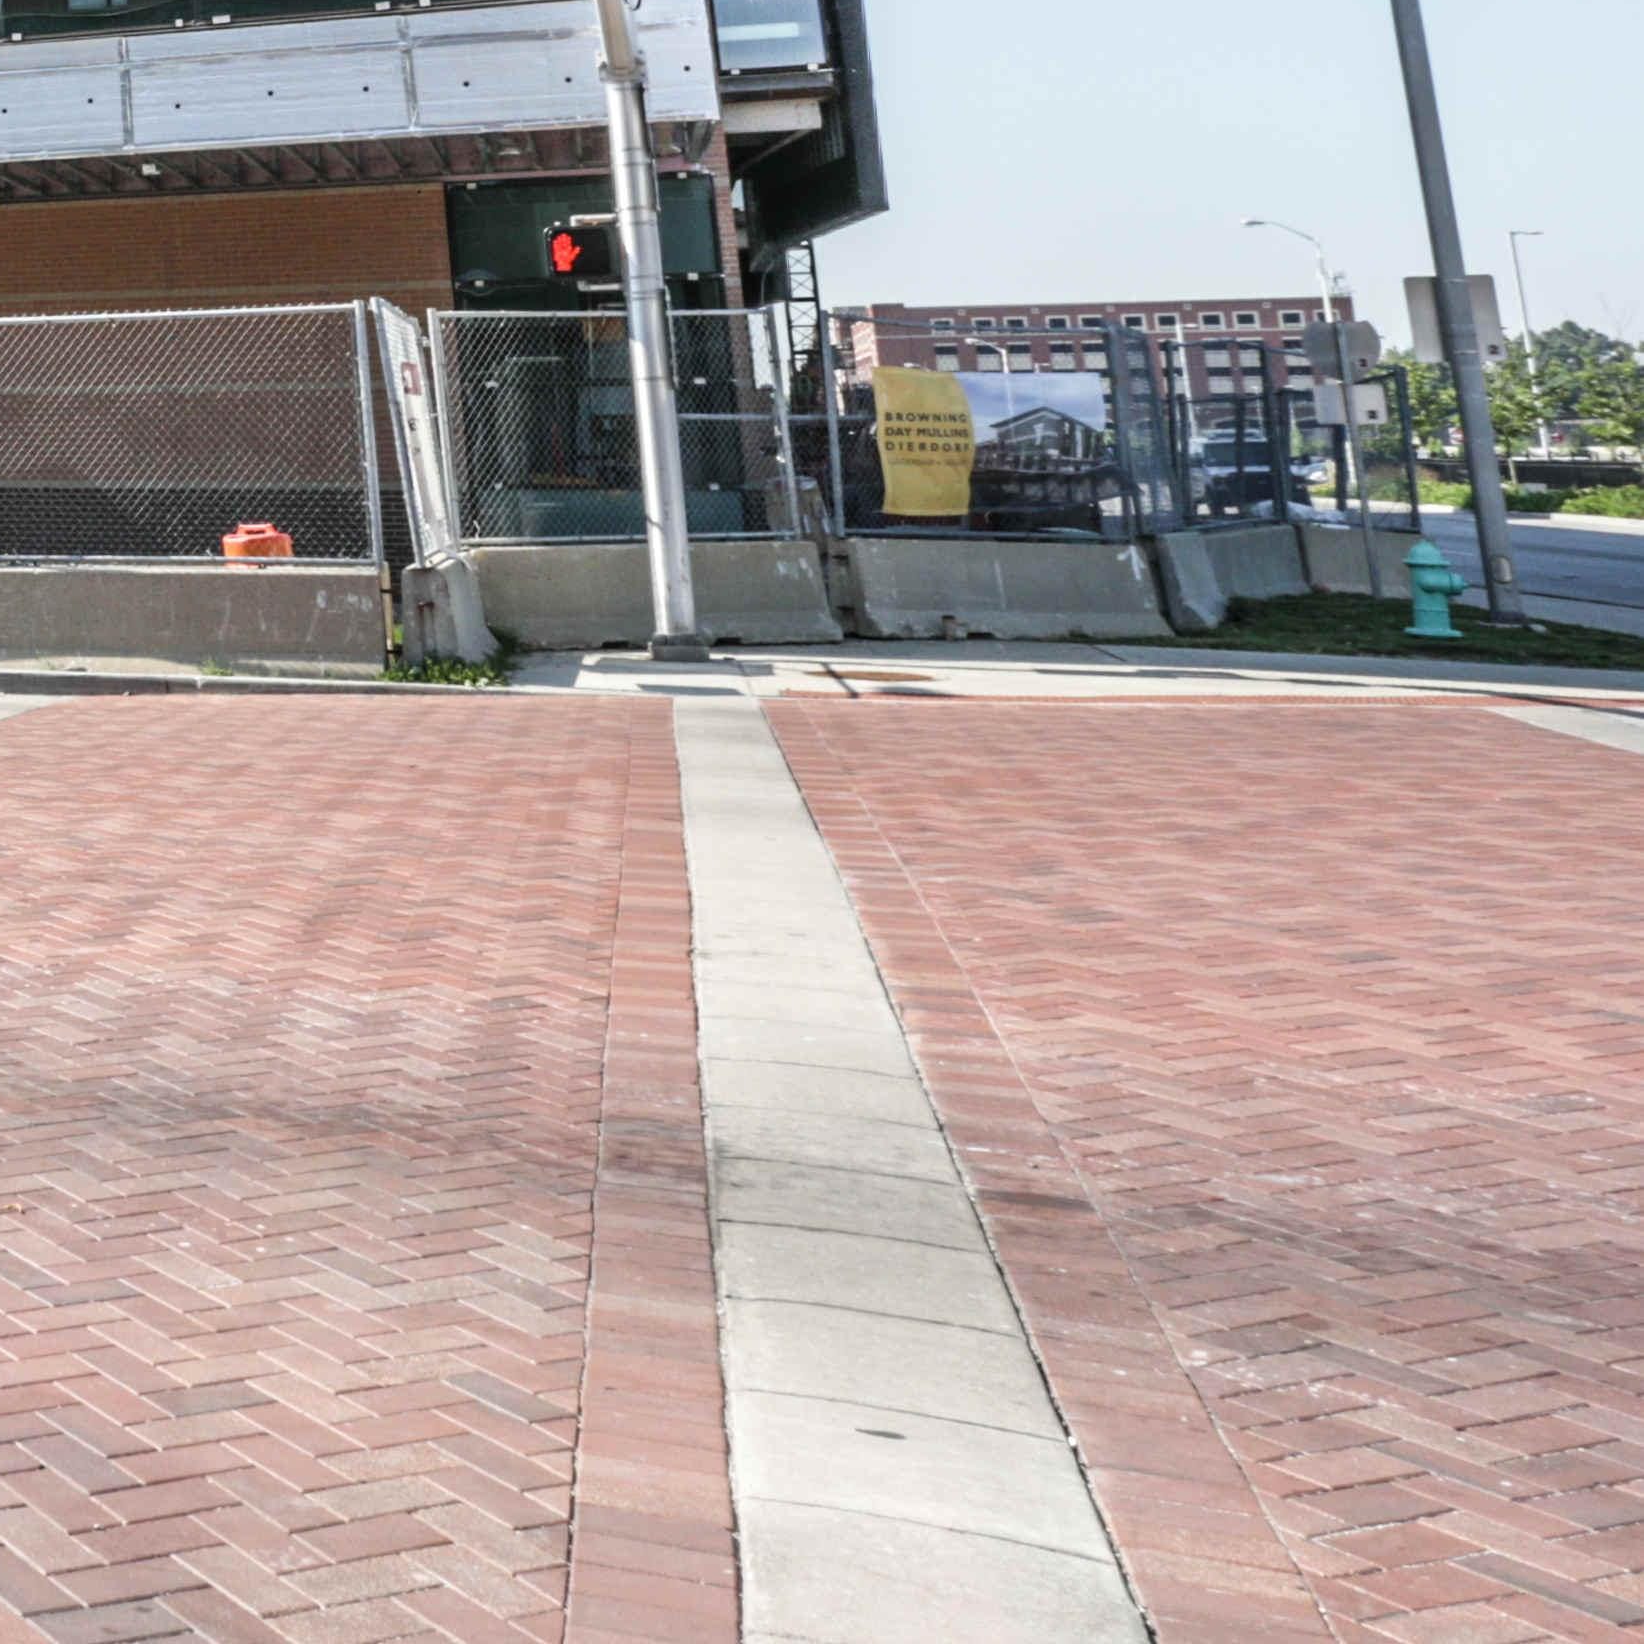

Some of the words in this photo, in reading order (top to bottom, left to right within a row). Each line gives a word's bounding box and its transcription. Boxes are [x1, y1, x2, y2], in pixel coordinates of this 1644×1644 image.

[885, 412, 967, 423] BROWNING
[885, 427, 912, 437] DAY
[917, 427, 969, 438] MULLINS
